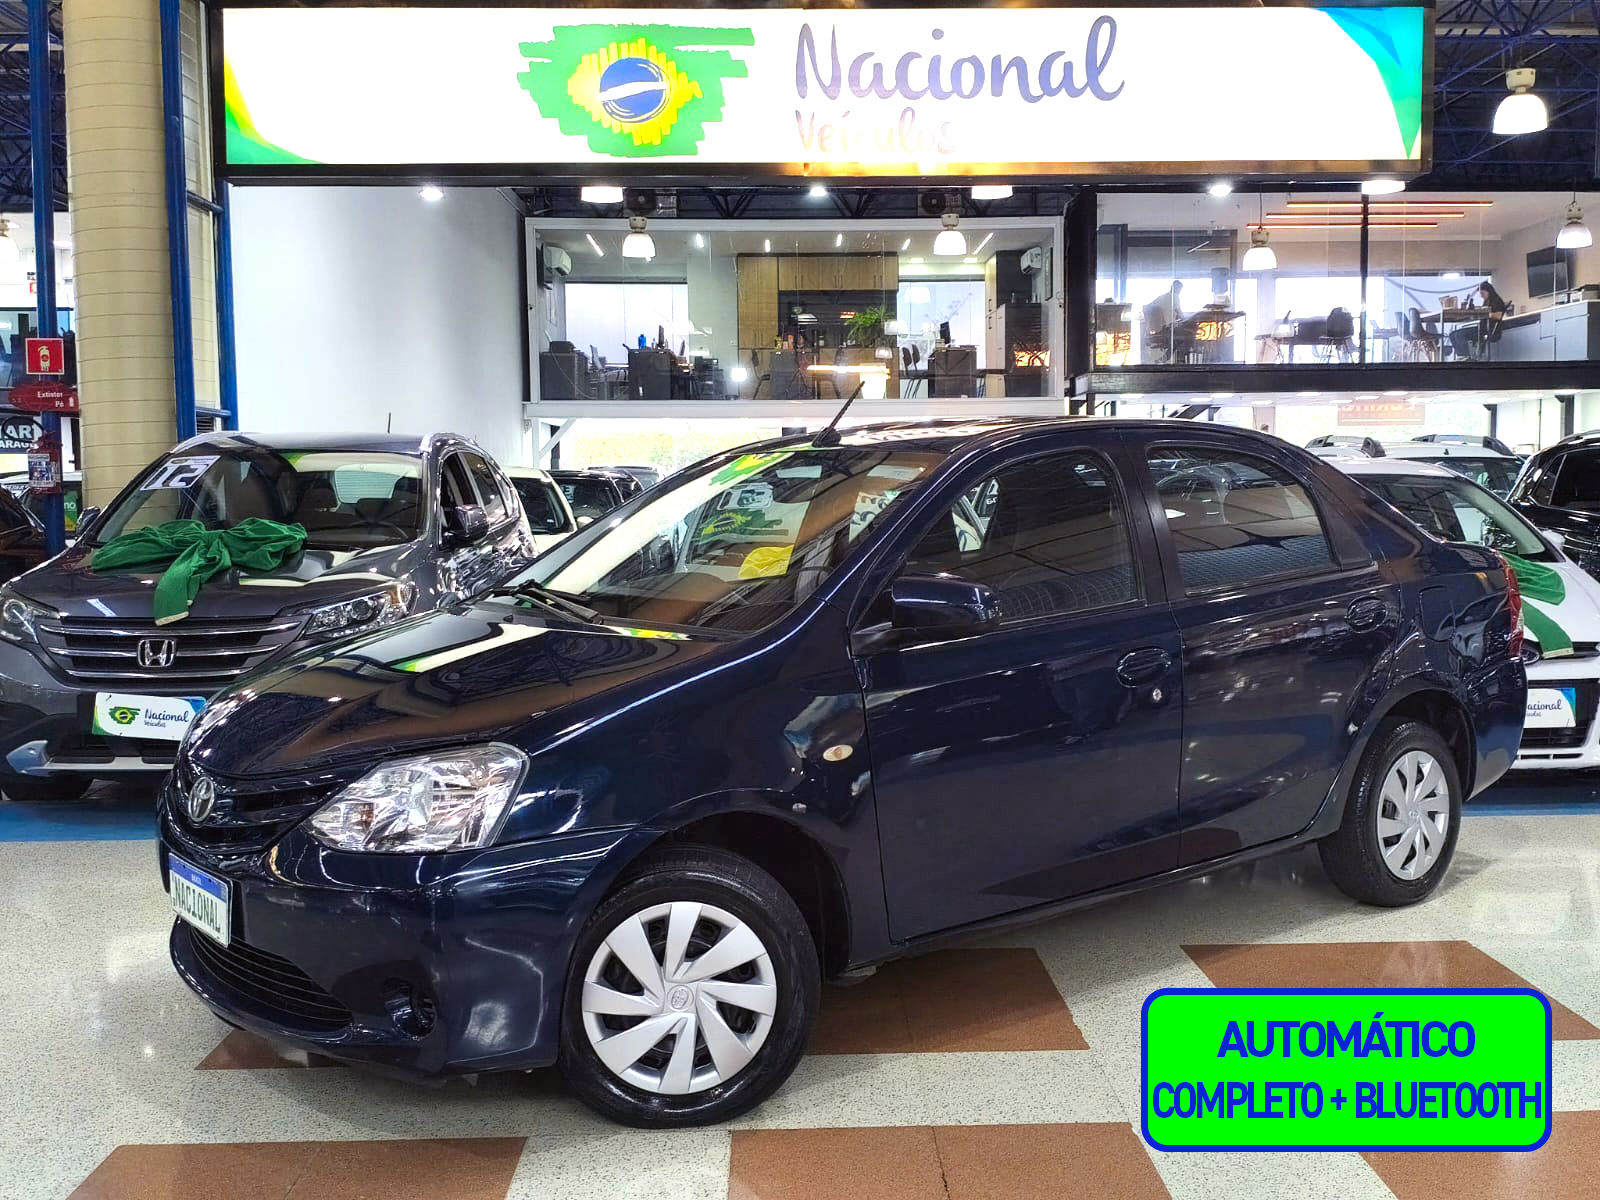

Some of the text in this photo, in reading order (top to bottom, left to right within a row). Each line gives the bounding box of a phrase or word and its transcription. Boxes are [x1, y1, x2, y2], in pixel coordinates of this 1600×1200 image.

[795, 15, 1124, 103] Nacional
[794, 106, 956, 154] Veíulos
[145, 708, 189, 722] Nacional
[1527, 698, 1563, 711] acional
[174, 877, 221, 933] NACIONAL
